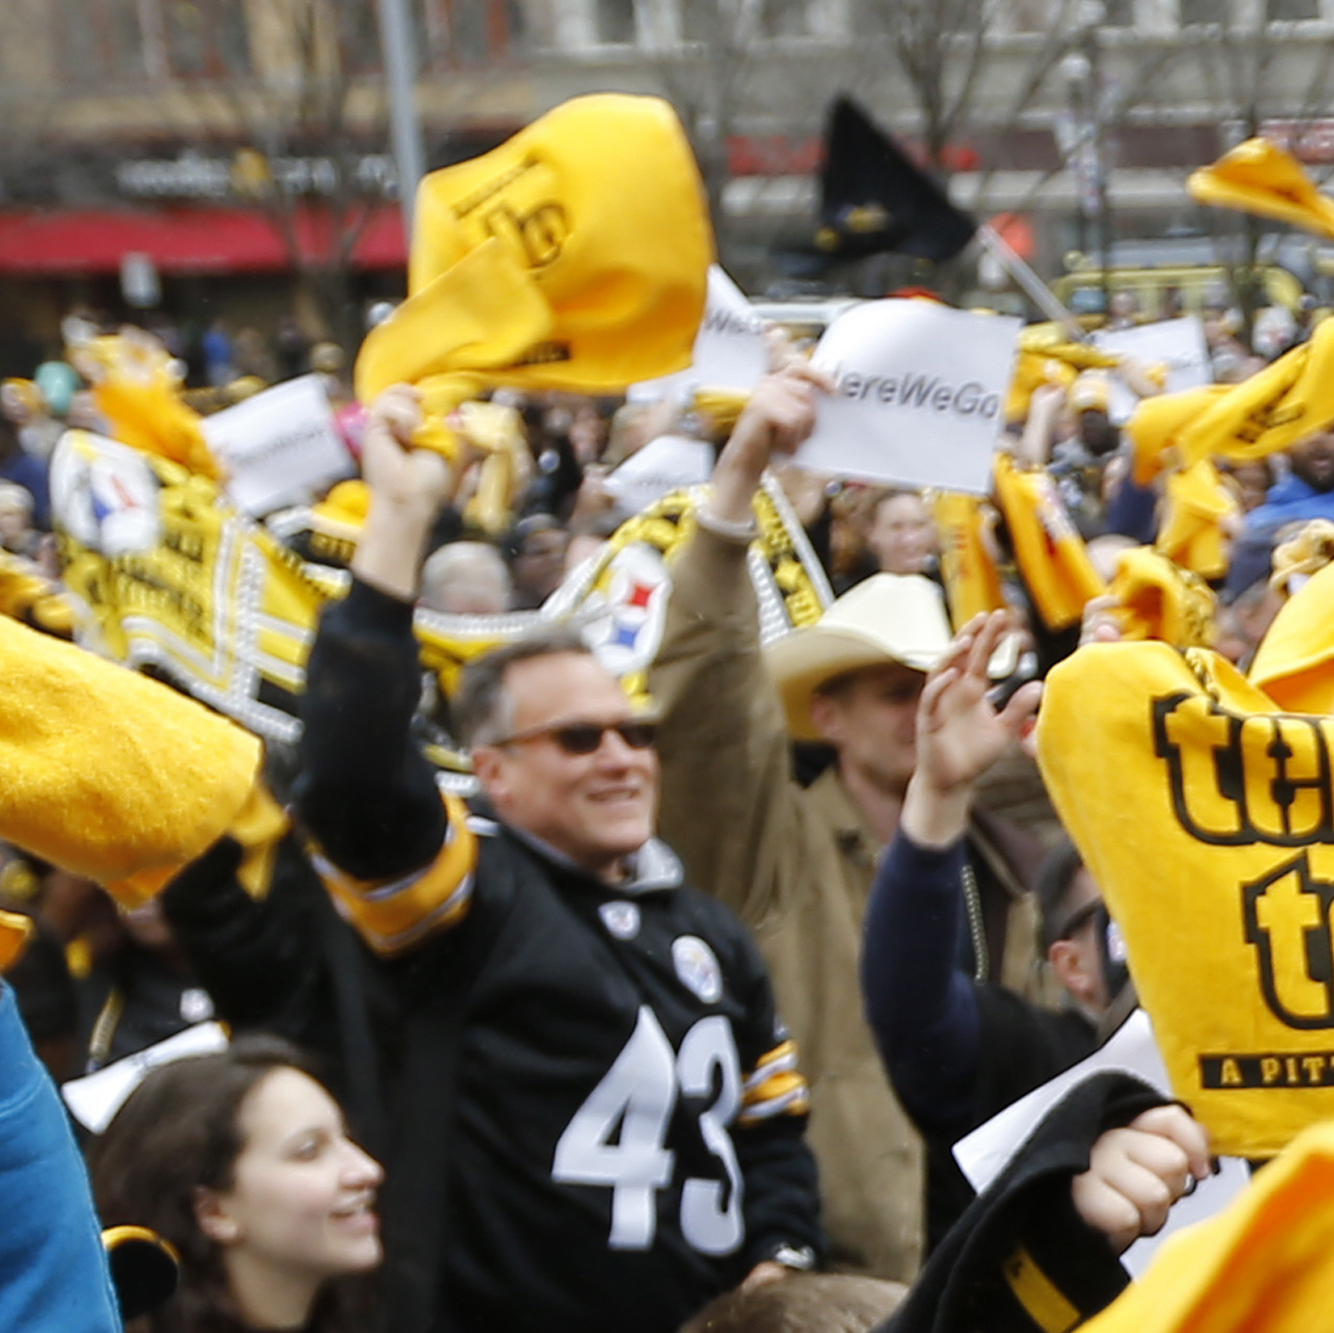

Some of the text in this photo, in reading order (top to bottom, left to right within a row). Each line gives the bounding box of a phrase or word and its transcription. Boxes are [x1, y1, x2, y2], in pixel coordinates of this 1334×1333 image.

[833, 361, 1002, 419] ereWeGo
[1221, 1057, 1242, 1084] A
[552, 1004, 745, 1256] 43
